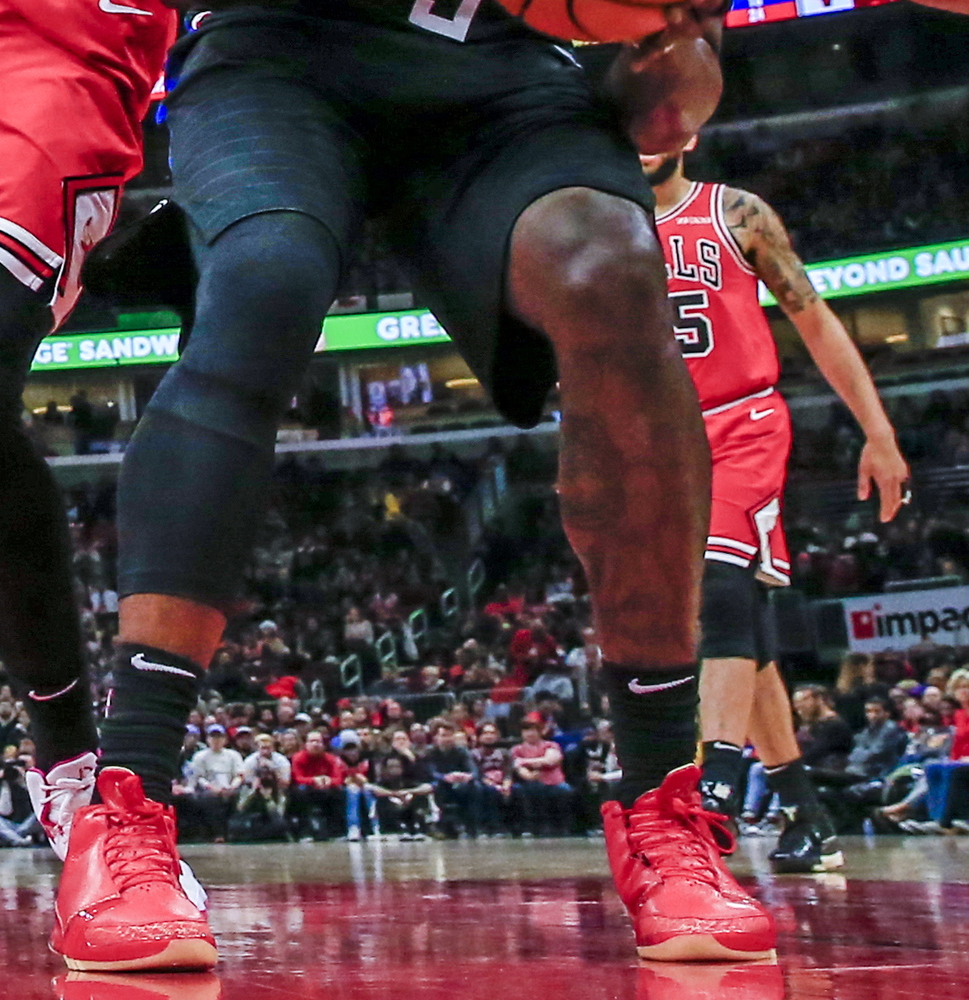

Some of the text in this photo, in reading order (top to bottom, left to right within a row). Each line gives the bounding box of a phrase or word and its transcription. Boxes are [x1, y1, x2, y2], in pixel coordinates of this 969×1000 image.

[665, 235, 722, 291] LS
[376, 313, 448, 341] GRE
[668, 289, 715, 358] 5
